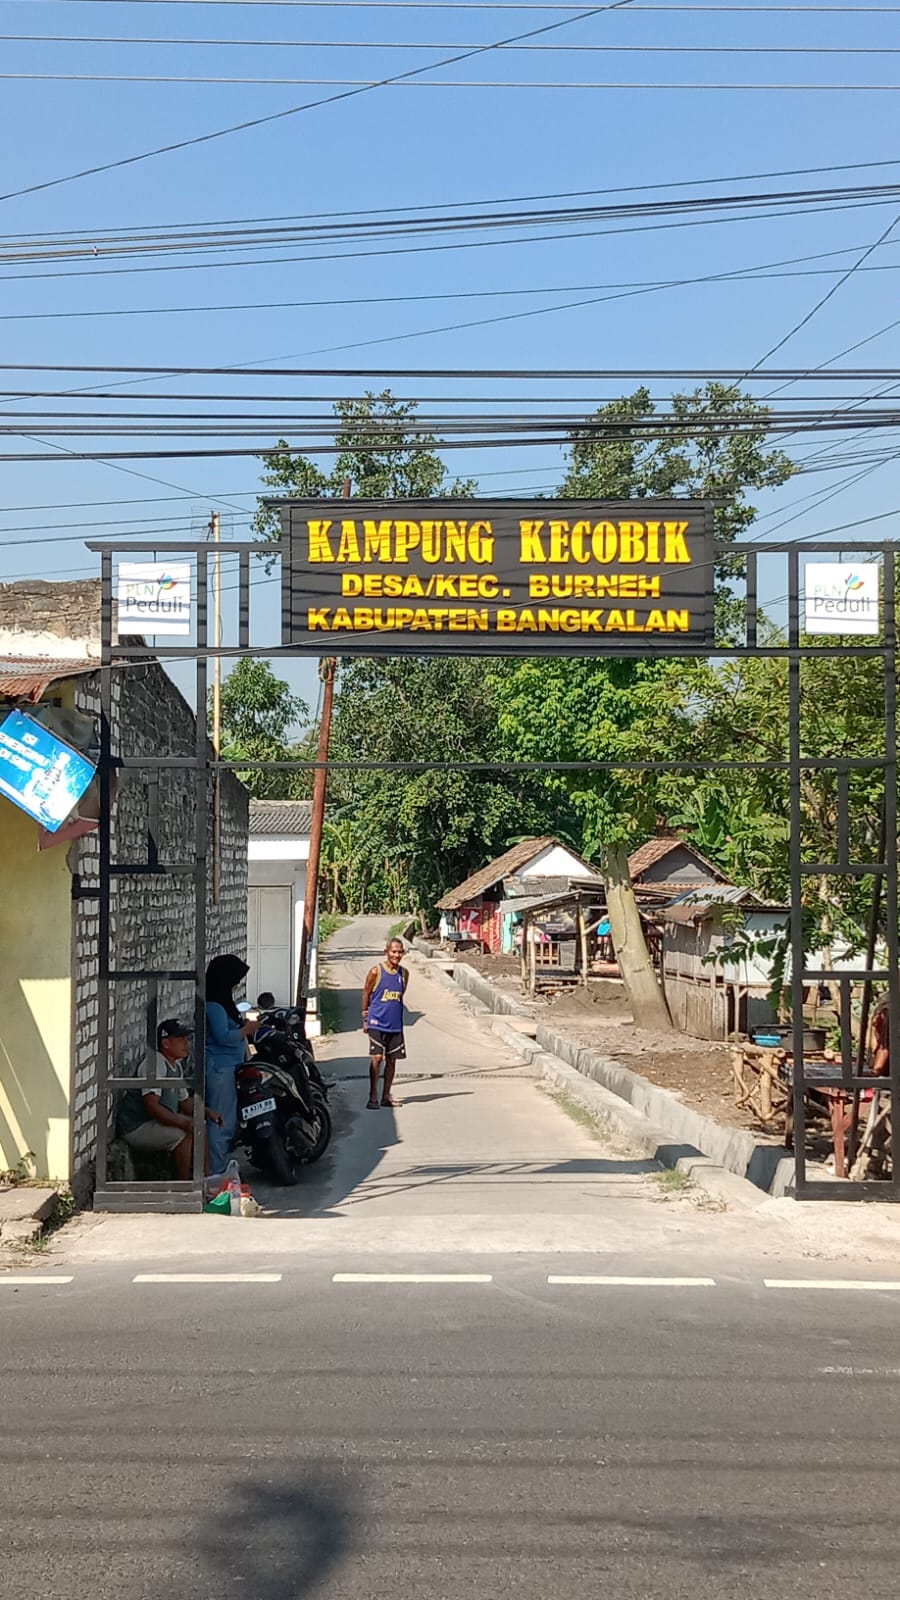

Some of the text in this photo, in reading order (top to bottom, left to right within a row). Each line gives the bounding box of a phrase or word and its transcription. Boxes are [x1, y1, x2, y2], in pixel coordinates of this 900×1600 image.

[307, 520, 691, 563] KAMPUNG KECOBIK
[126, 584, 154, 596] PLN
[341, 573, 661, 598] DESA/KEC. BURNEH
[813, 585, 842, 597] PLN
[126, 596, 182, 613] Peduli
[813, 596, 870, 613] Peduli
[308, 607, 690, 632] KABUPATEN BANGKALAN
